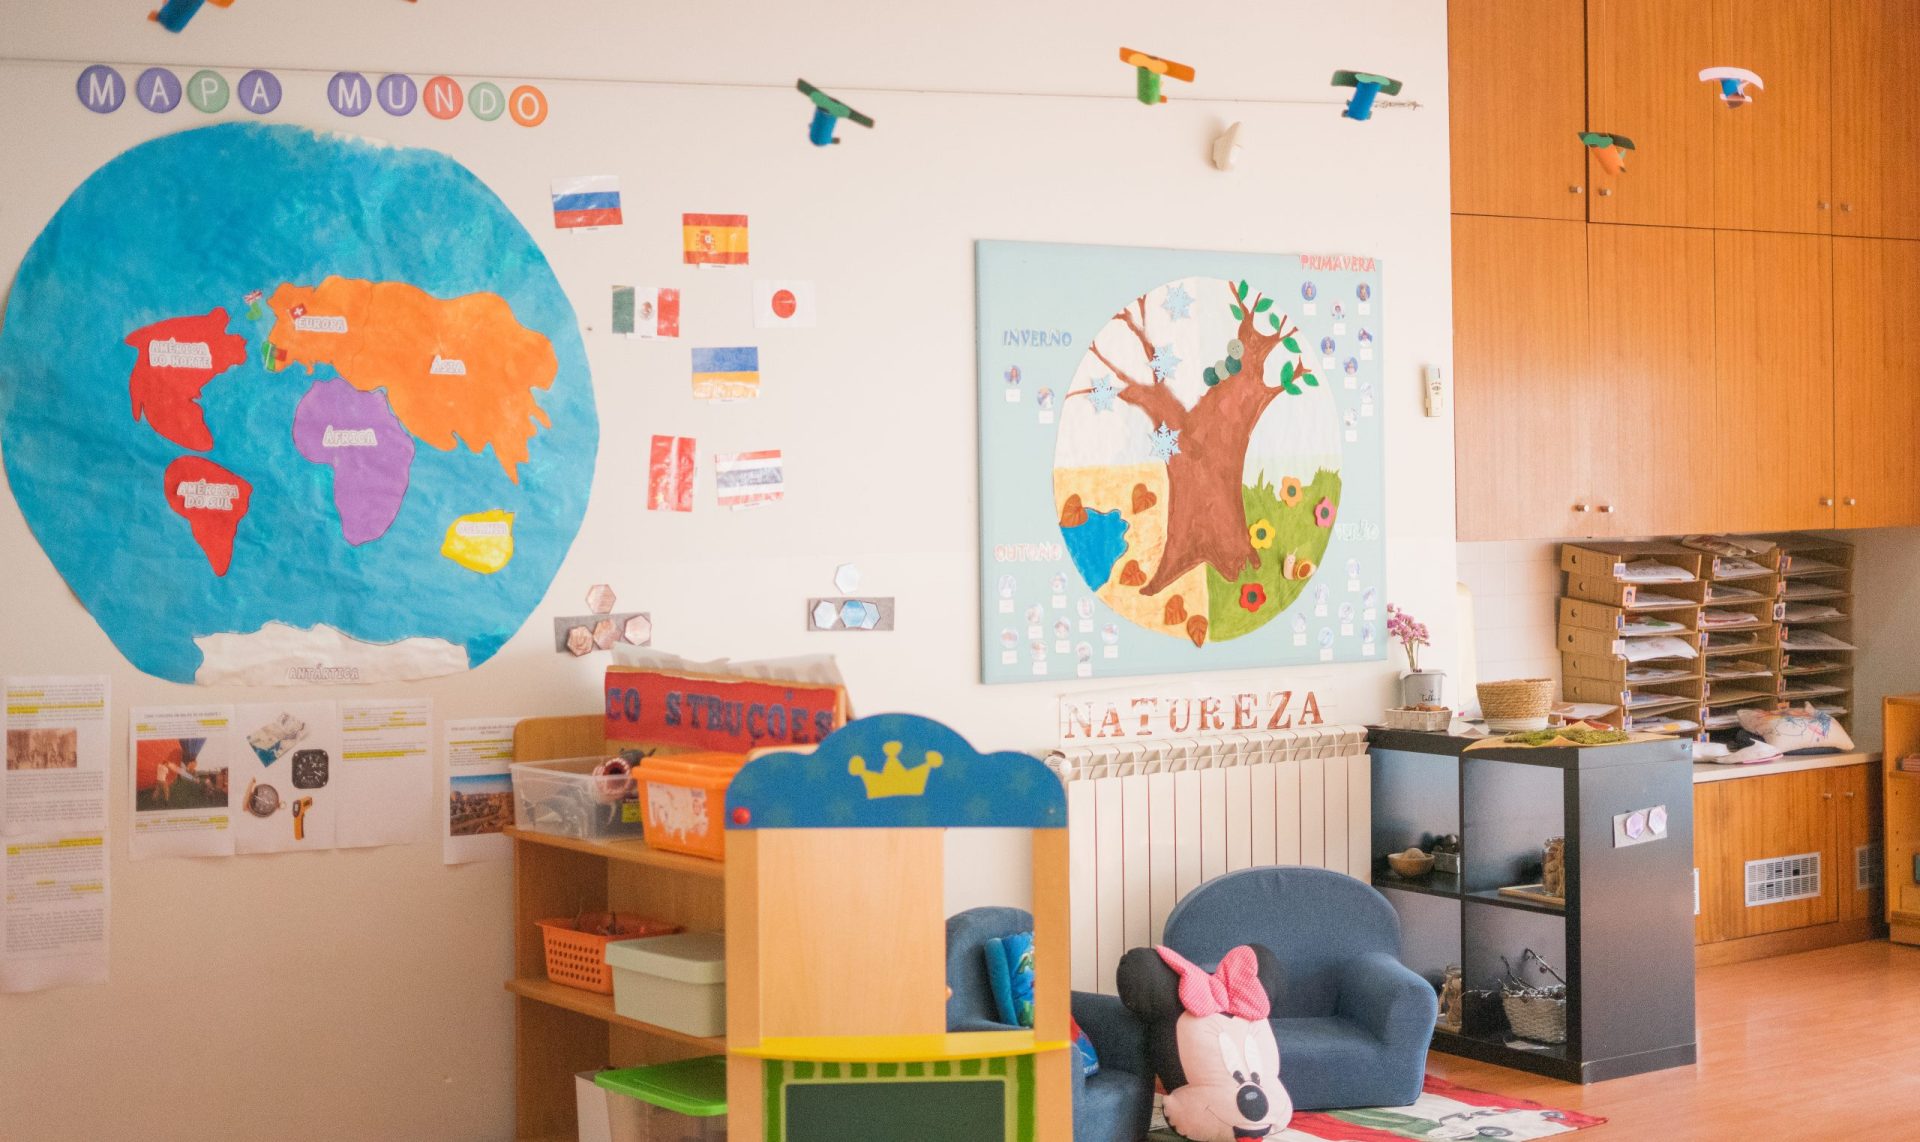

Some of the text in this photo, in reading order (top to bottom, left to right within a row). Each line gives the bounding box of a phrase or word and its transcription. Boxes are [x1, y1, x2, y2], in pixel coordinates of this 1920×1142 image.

[87, 71, 542, 122] MAPA MUNDO
[1299, 254, 1377, 273] PRIMAVERA
[296, 316, 347, 332] EUROPA
[1002, 328, 1073, 348] INVERNO
[323, 425, 377, 446] ÁFRICA
[178, 480, 238, 497] AMÉRICA
[186, 495, 232, 510] DO SUL
[288, 662, 360, 680] ANTÁRTICA
[1064, 690, 1324, 739] NATUREZA
